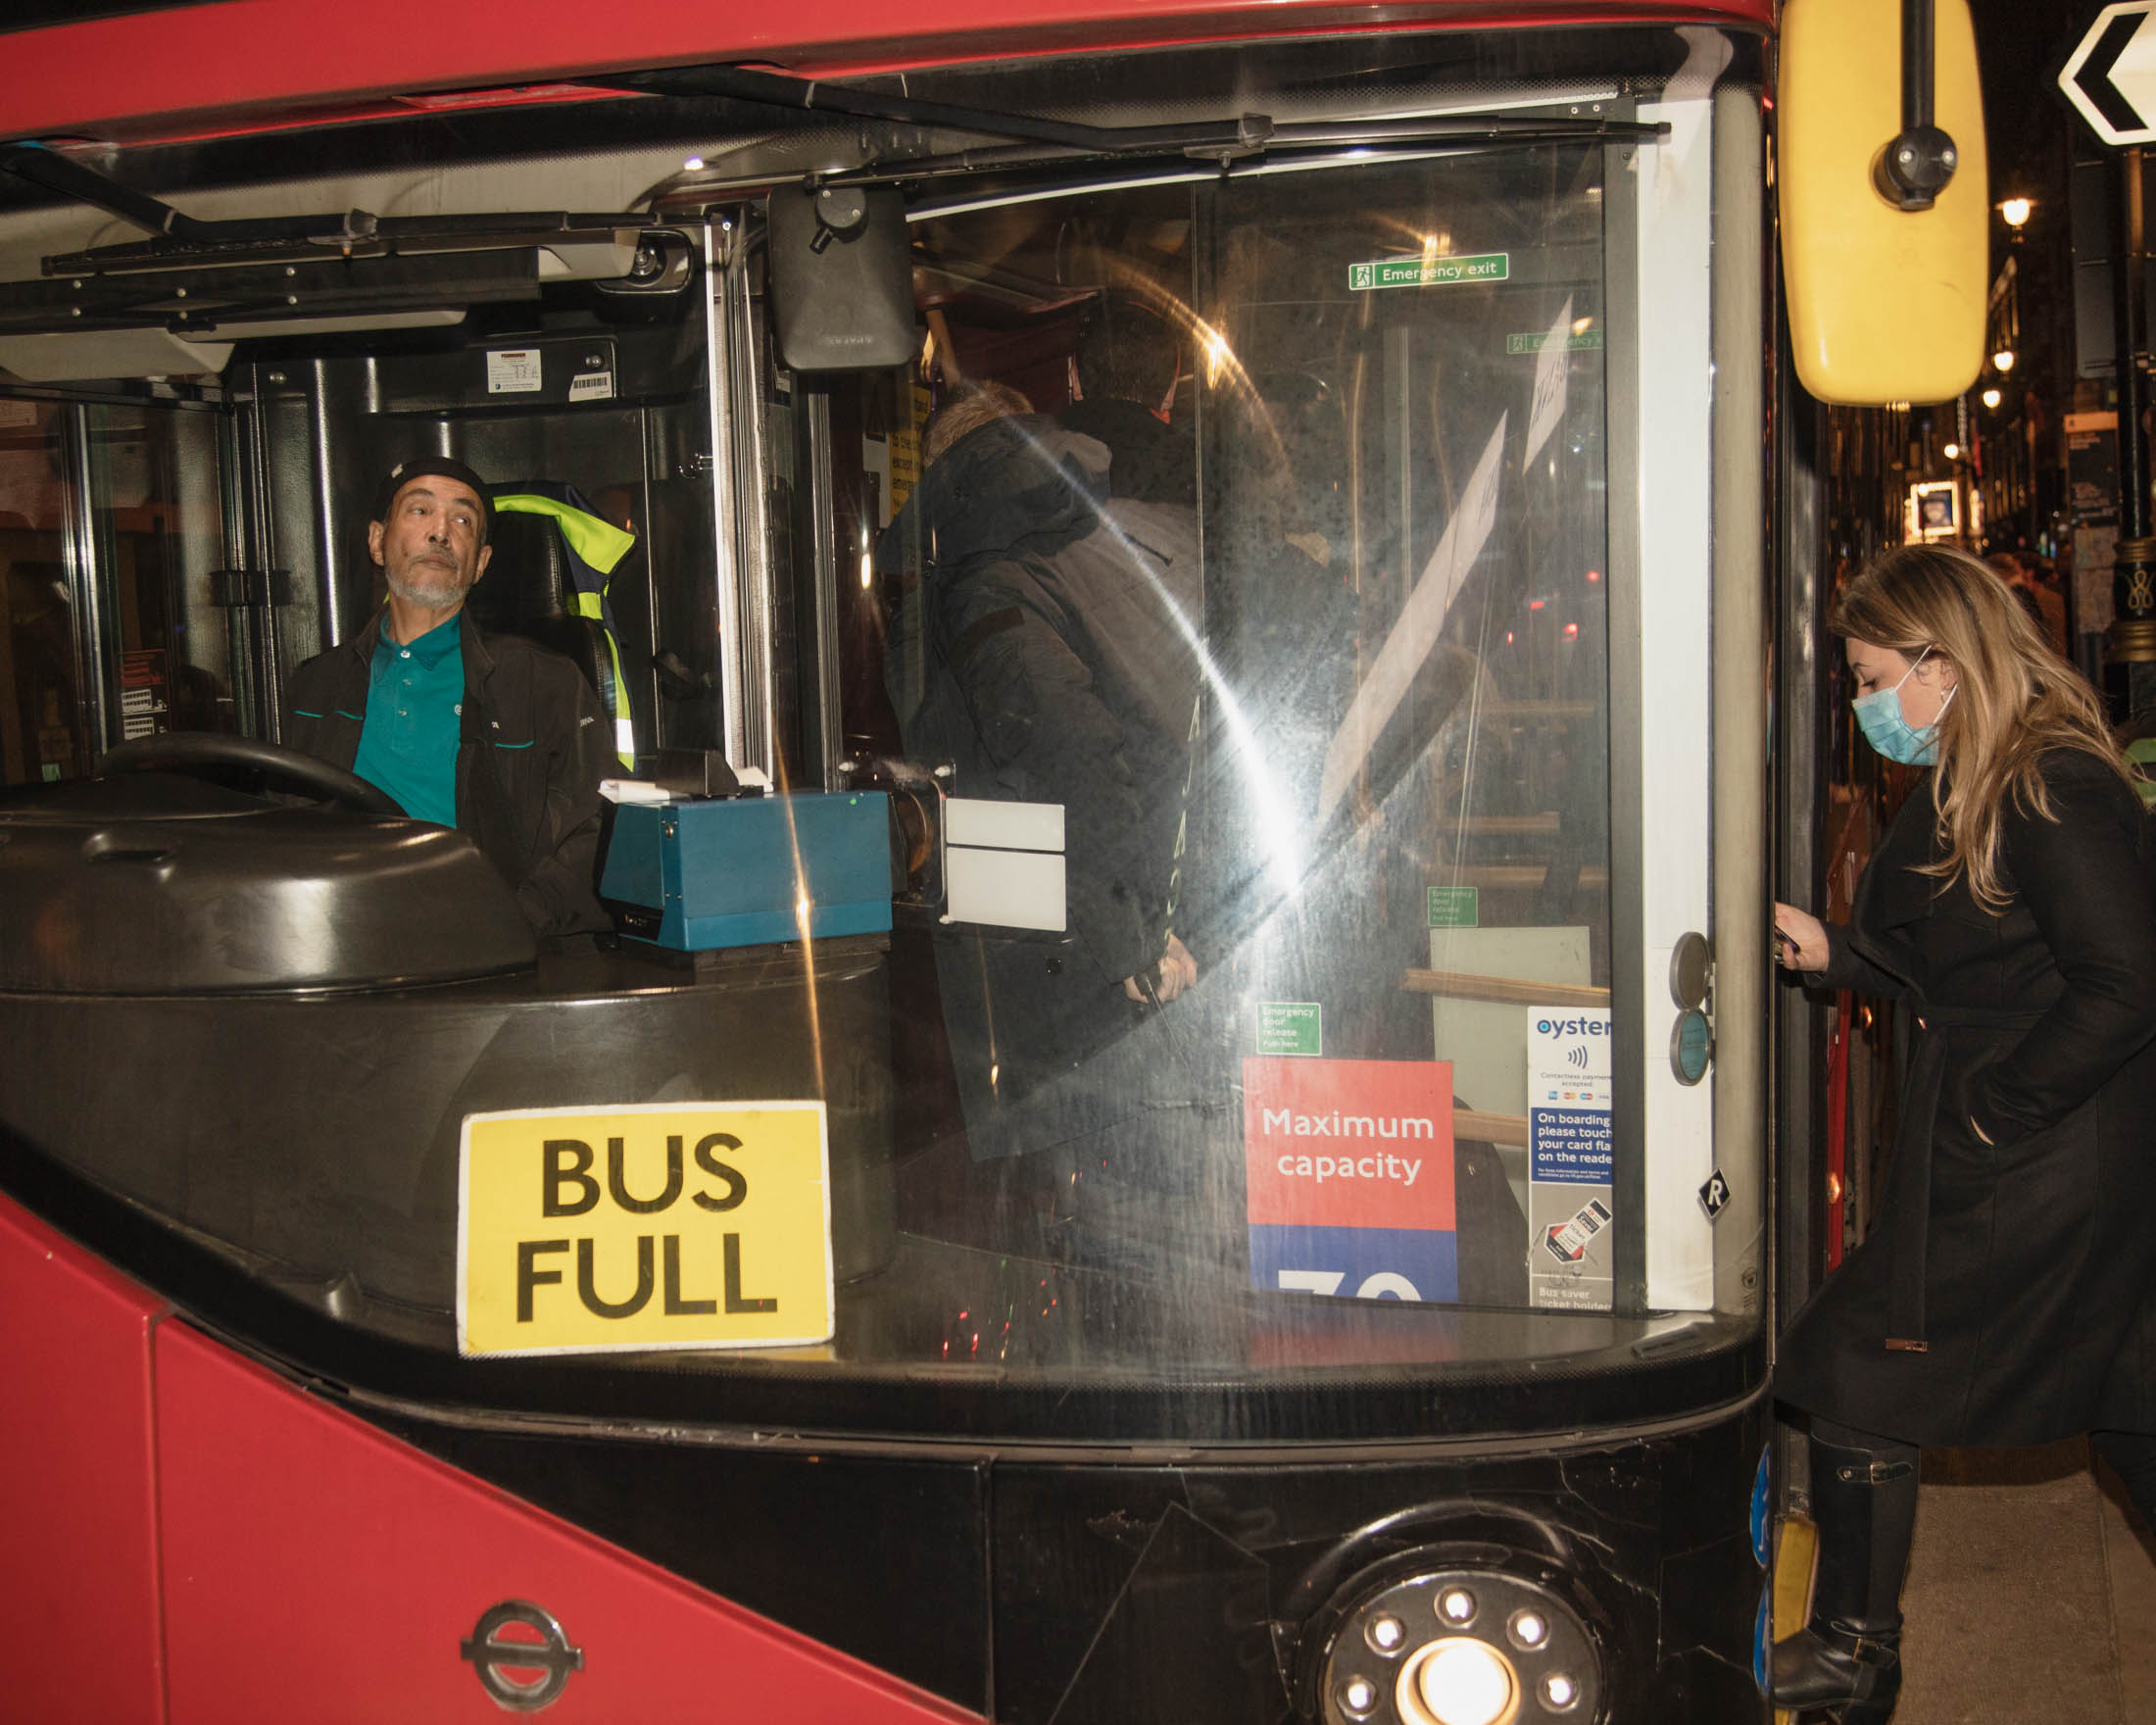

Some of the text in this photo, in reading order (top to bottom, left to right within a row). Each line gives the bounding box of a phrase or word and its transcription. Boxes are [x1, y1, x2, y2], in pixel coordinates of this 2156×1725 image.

[1383, 261, 1497, 281] Emergency exit
[1433, 890, 1473, 899] Emergency
[1261, 1006, 1314, 1018] Emergency
[1261, 1018, 1287, 1027] door
[1537, 1016, 1613, 1040] oyster
[1261, 1028, 1298, 1037] release
[1262, 1108, 1434, 1139] Maximum
[1538, 1112, 1611, 1128] On boarding
[1538, 1126, 1613, 1138] please touch
[1538, 1139, 1611, 1151] your card fla
[1538, 1152, 1613, 1164] on the reade
[543, 1133, 748, 1218] BUS
[1277, 1152, 1422, 1186] capacity
[1707, 1178, 1723, 1207] R
[516, 1232, 778, 1323] FULL
[1540, 1286, 1557, 1298] Bus
